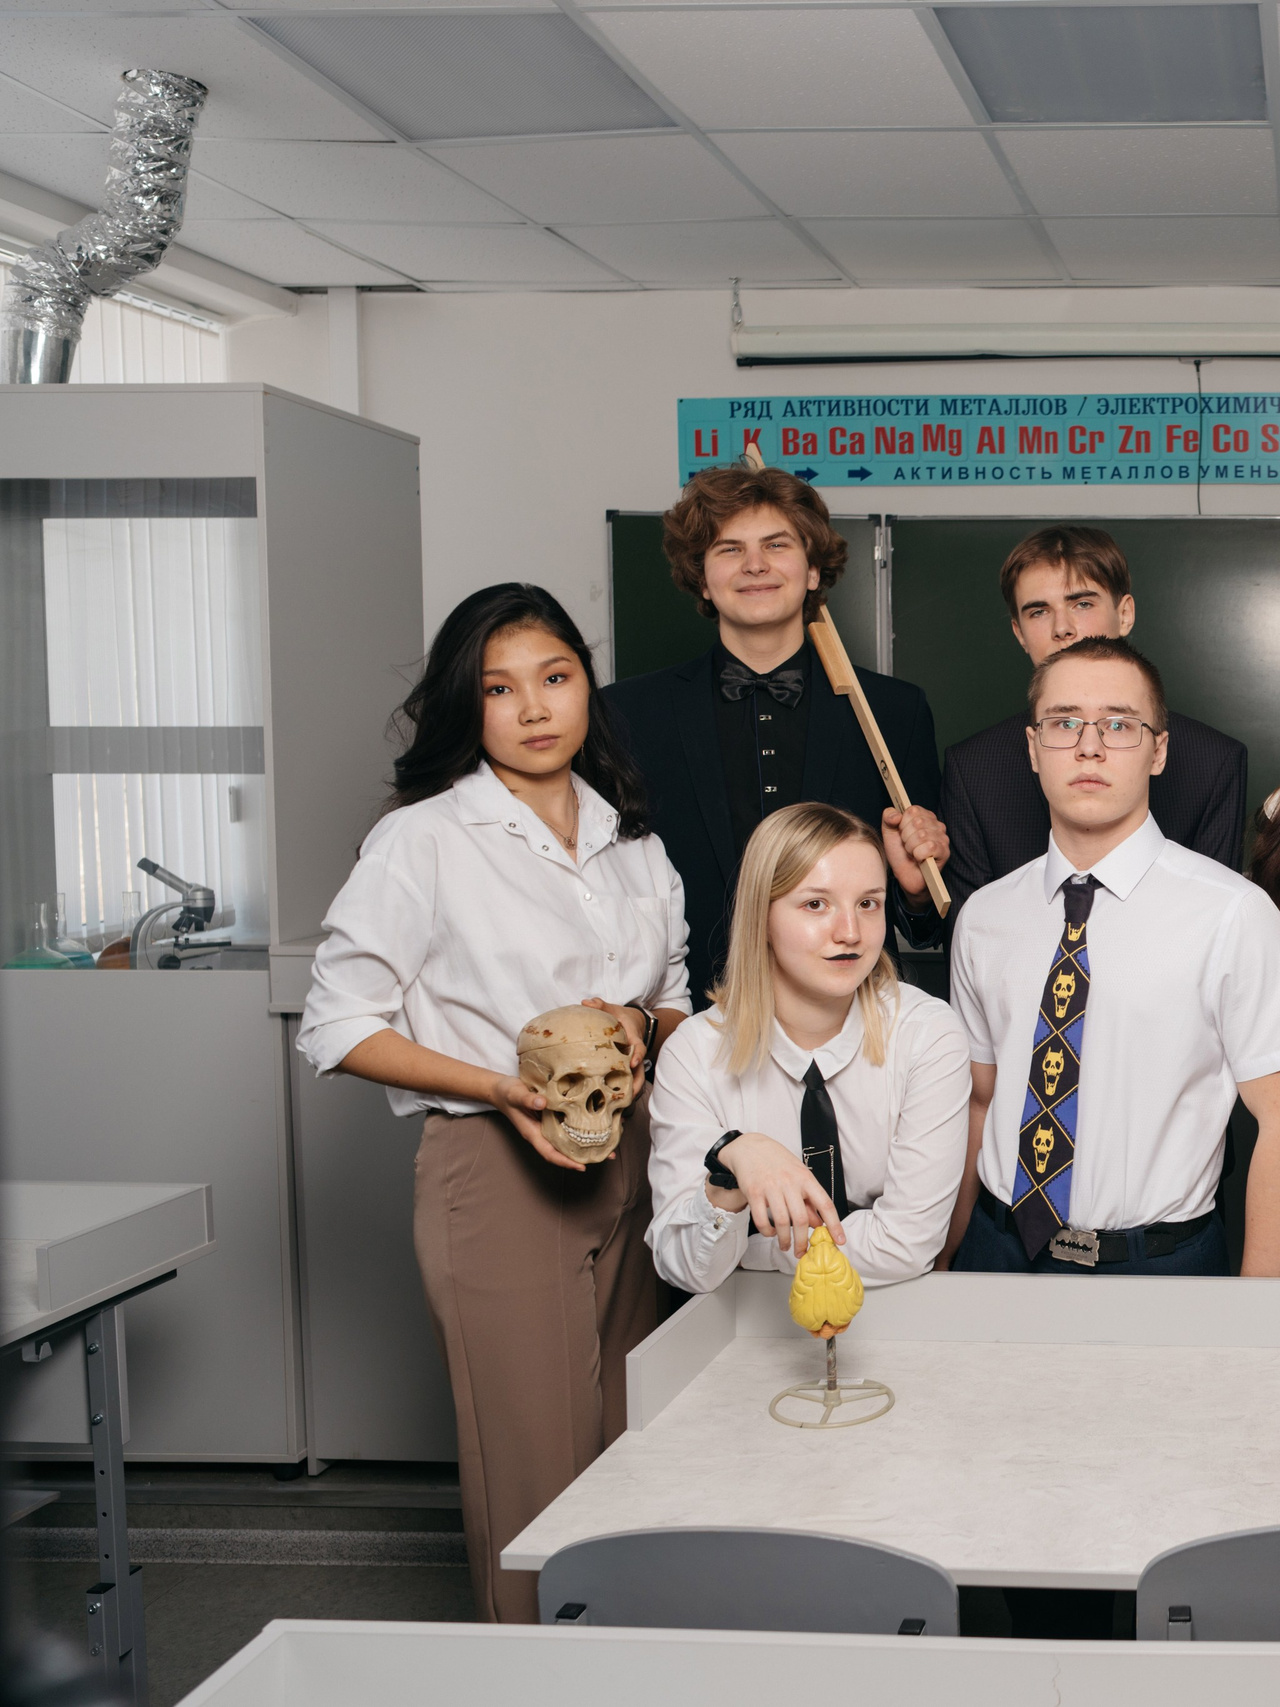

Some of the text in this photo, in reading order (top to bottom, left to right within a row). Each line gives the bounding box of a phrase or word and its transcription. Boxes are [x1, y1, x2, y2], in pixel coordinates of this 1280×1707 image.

[729, 401, 773, 420] РЯД
[782, 398, 930, 418] АКТИВНОСТИ
[940, 397, 1067, 417] МЕТАЛЛОВ
[694, 429, 718, 457] Li
[782, 427, 818, 456] Ba
[829, 426, 865, 456] Ca
[874, 426, 914, 454] Na
[922, 423, 962, 457] Mg
[976, 426, 1005, 454] Al
[1018, 426, 1058, 454] Mn
[1068, 425, 1105, 454] Cr
[1118, 425, 1151, 454] Zn
[1166, 424, 1199, 453] Fe
[1212, 424, 1249, 453] Co
[893, 466, 1052, 480] АКТИВНОСТЬ
[1062, 465, 1190, 480] МЕТАЛЛОВ
